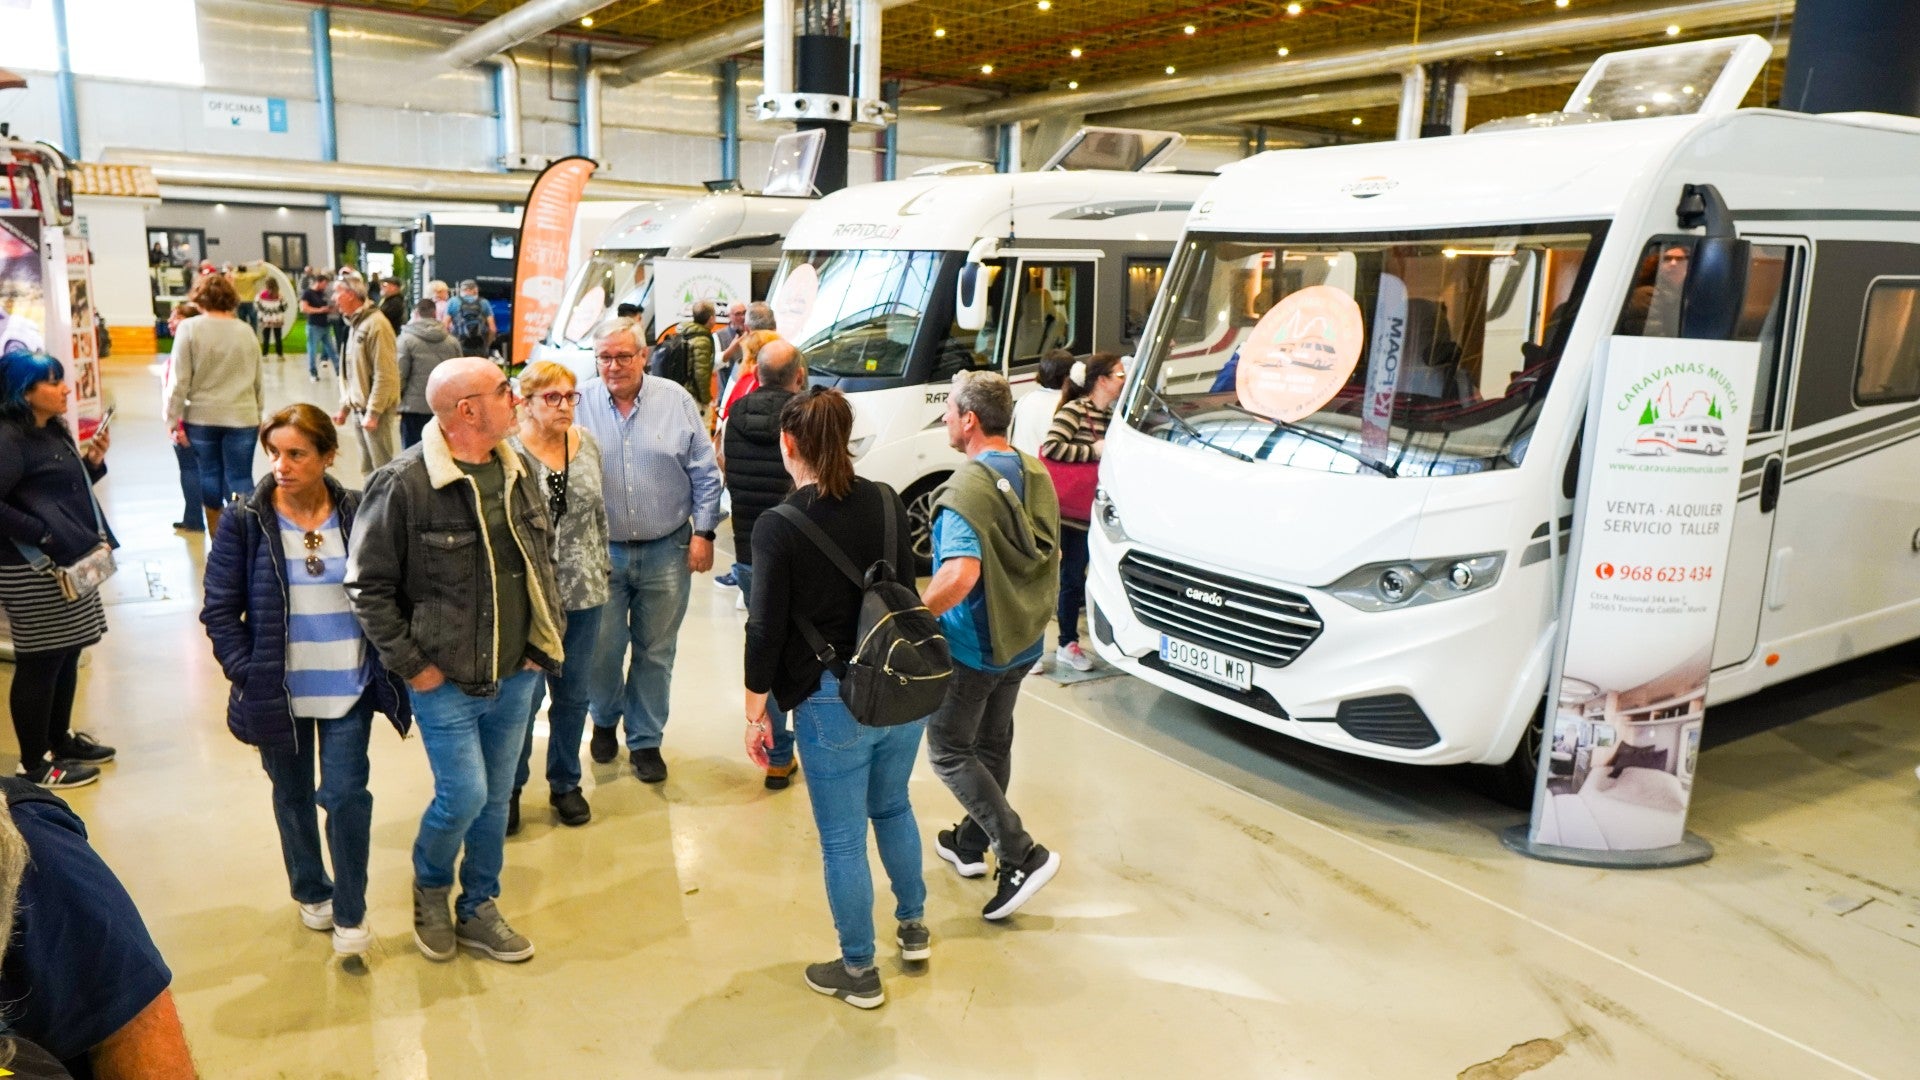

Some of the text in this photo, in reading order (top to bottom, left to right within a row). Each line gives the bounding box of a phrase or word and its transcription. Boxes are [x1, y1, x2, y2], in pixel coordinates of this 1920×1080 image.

[208, 100, 262, 114] OFICINAS
[1617, 362, 1738, 414] CARAVANAS MURCIA
[926, 392, 949, 404] RAP
[1609, 462, 1729, 474] www.caravanasmurcia.com
[1607, 501, 1723, 518] VENTA ALQUILER
[1603, 519, 1720, 535] SERVICIO TALLER
[1619, 565, 1713, 582] 968 623 434
[1185, 587, 1223, 607] carado
[1613, 594, 1649, 603] Nacional
[1618, 604, 1643, 613] Torres
[1645, 605, 1656, 613] de
[1170, 641, 1245, 683] 9098 LWR
